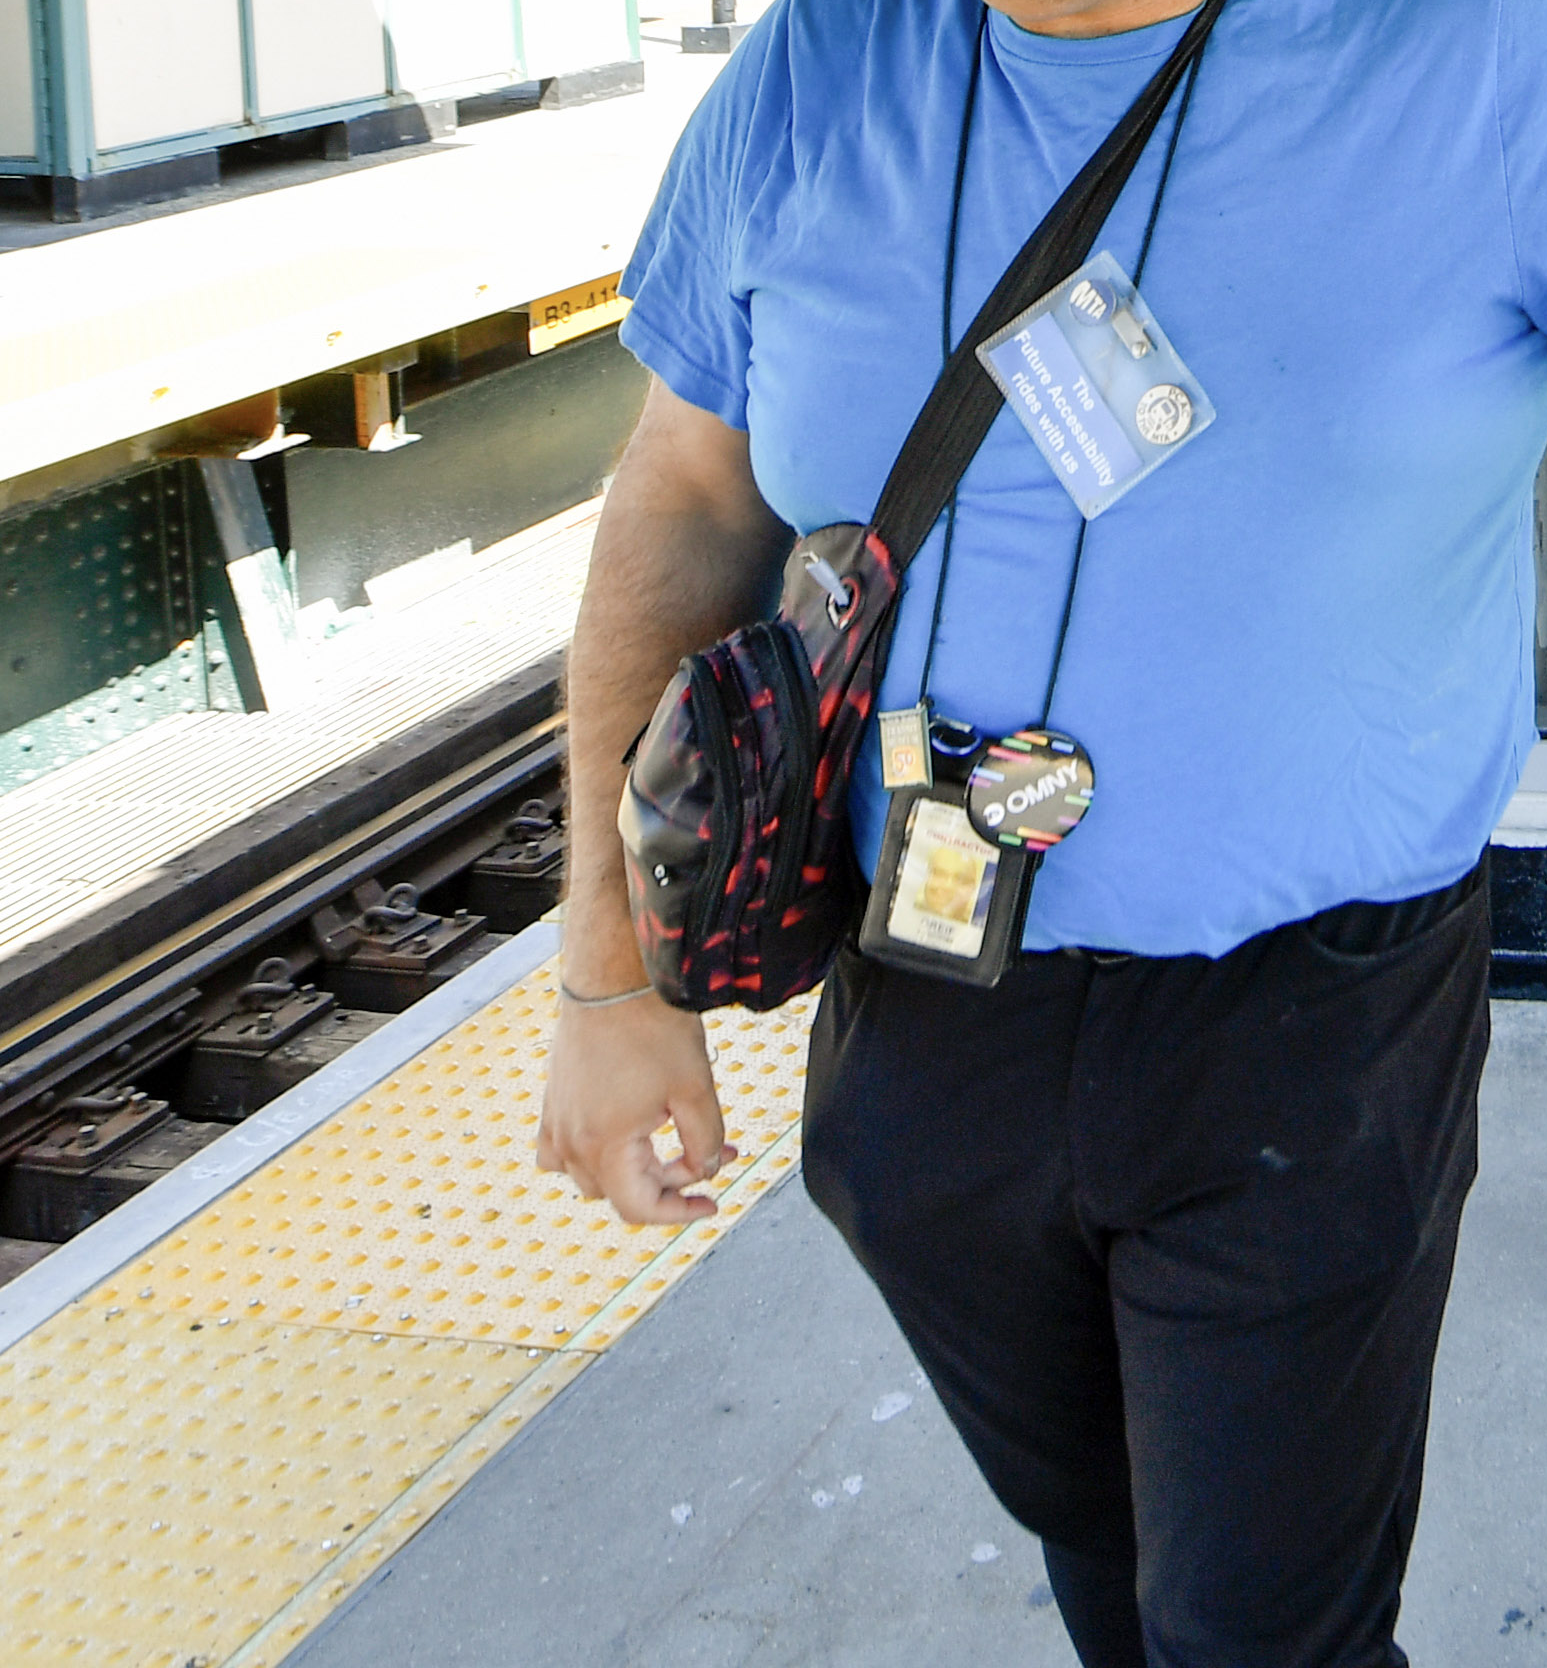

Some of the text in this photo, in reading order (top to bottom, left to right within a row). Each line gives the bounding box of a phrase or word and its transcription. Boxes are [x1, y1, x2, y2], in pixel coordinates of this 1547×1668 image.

[1070, 279, 1107, 320] MTA
[1014, 330, 1115, 487] Future Accessibility
[1071, 375, 1095, 412] The
[1012, 371, 1079, 475] rides with us
[1006, 759, 1079, 815] OMNY
